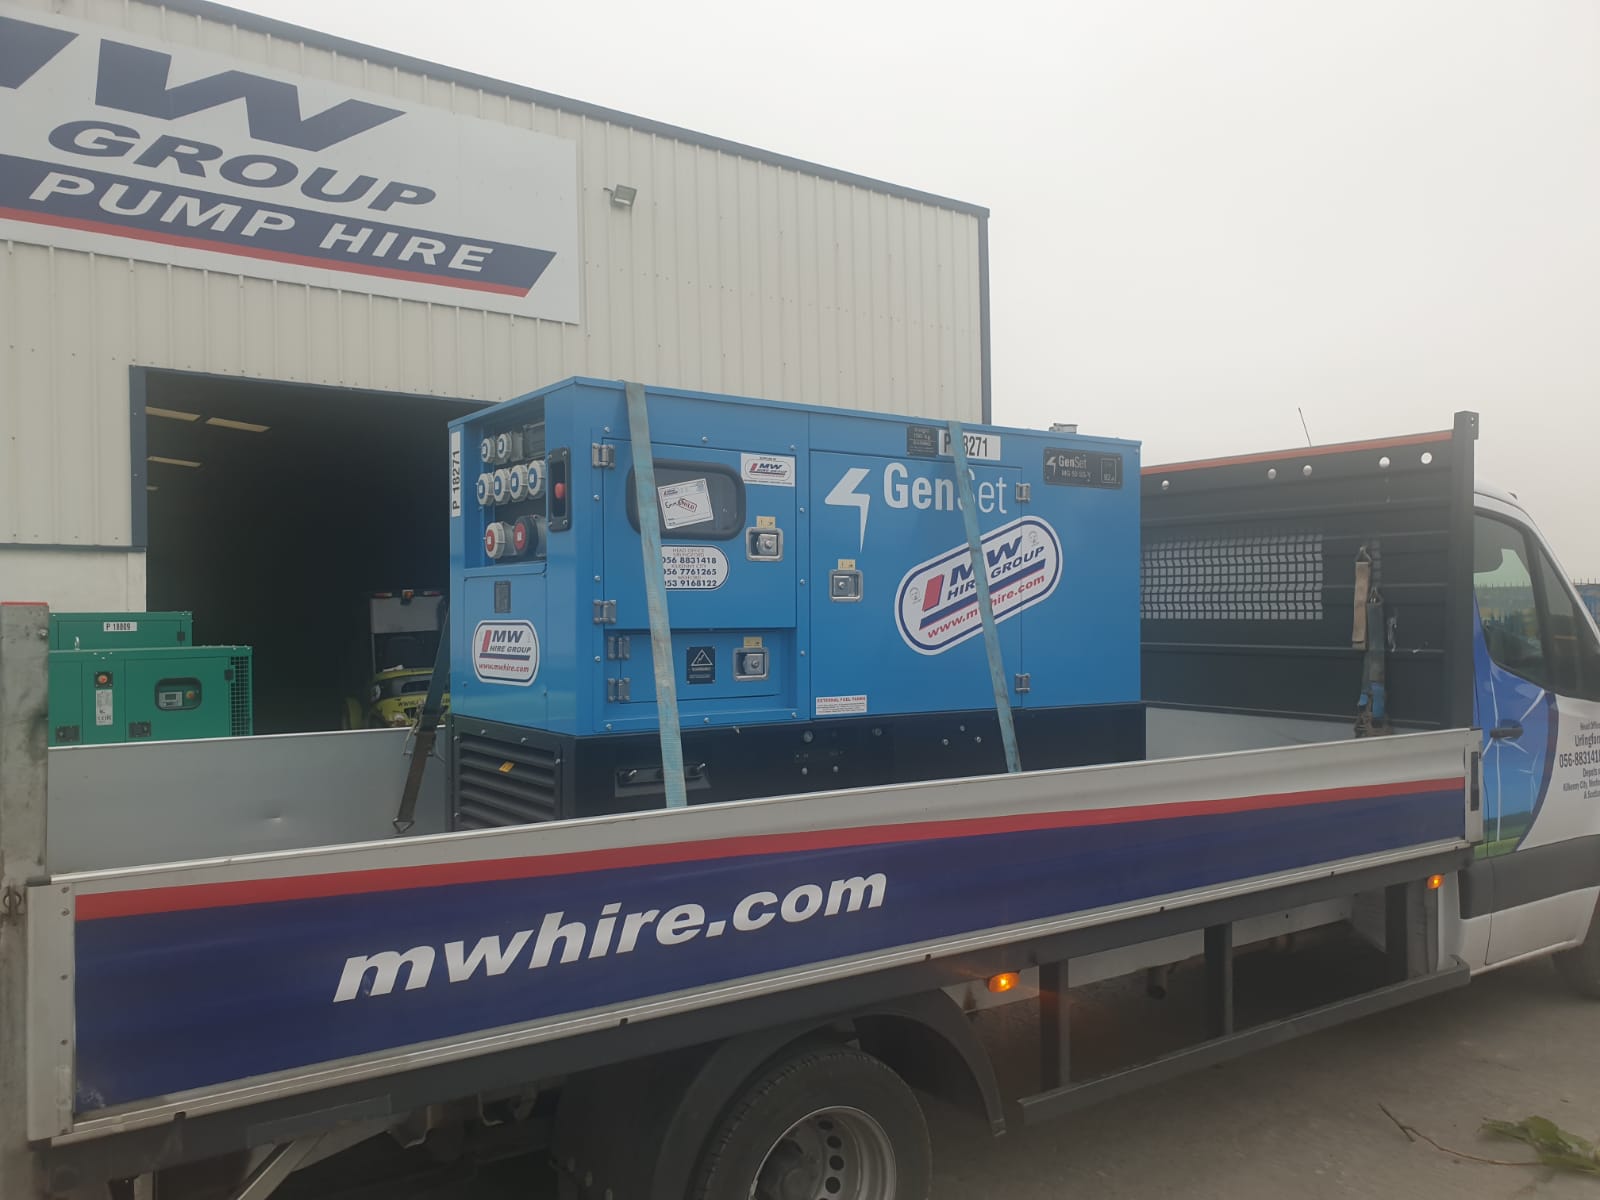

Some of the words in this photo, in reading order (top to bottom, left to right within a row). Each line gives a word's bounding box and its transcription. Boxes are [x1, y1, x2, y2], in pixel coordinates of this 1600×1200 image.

[0, 16, 406, 152] W
[48, 120, 437, 212] GROUP
[29, 172, 295, 237] PUMP
[319, 223, 493, 273] HIRE
[943, 433, 951, 453] P
[1059, 455, 1087, 469] GenSet
[452, 500, 460, 510] P
[680, 556, 717, 564] 8831418
[947, 579, 976, 601] HIR
[990, 546, 1045, 579] GROUP
[927, 575, 1045, 638] www.mhire.com
[492, 630, 525, 643] MW
[333, 872, 887, 1003] mwhire.com
